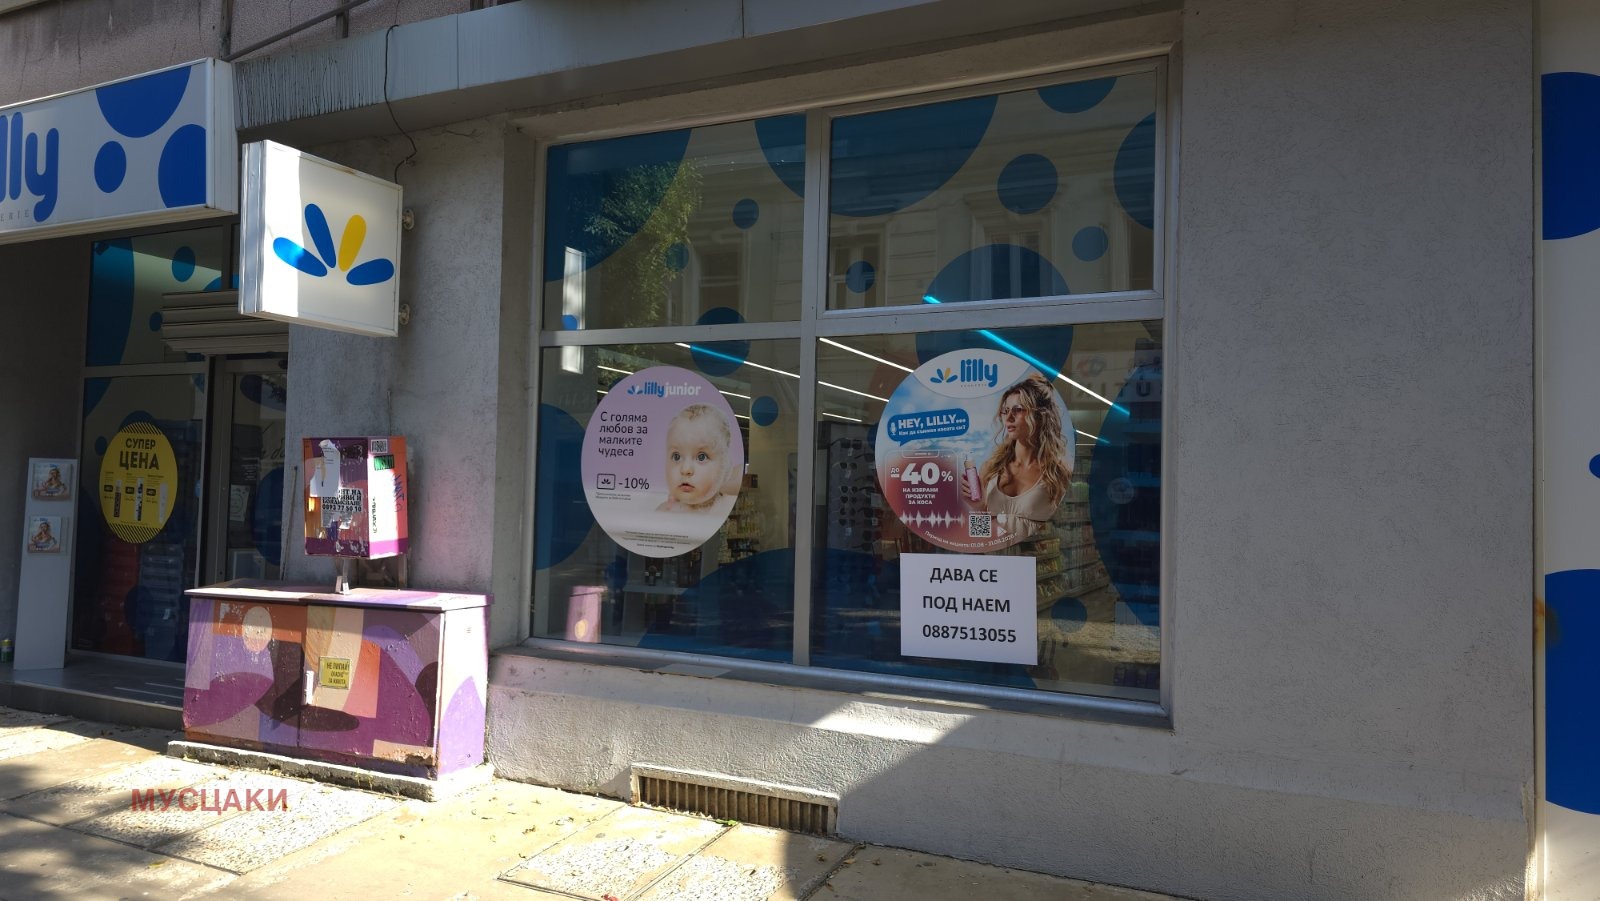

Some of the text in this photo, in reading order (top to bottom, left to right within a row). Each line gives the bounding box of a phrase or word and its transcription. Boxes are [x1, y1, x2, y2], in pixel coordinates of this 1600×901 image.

[961, 360, 998, 388] lilly
[600, 412, 648, 423] С голяма
[898, 414, 966, 429] HEY, LILLY...
[599, 424, 648, 434] любов за
[125, 438, 156, 450] СУПЕР
[599, 437, 643, 446] малките
[598, 447, 634, 458] чудеса
[119, 451, 160, 470] ЦЕНА
[618, 478, 650, 490] -10%
[930, 567, 998, 584] ДАВА СЕ
[923, 595, 1011, 613] ПОД НАЕМ
[922, 624, 1017, 643] 0887513055
